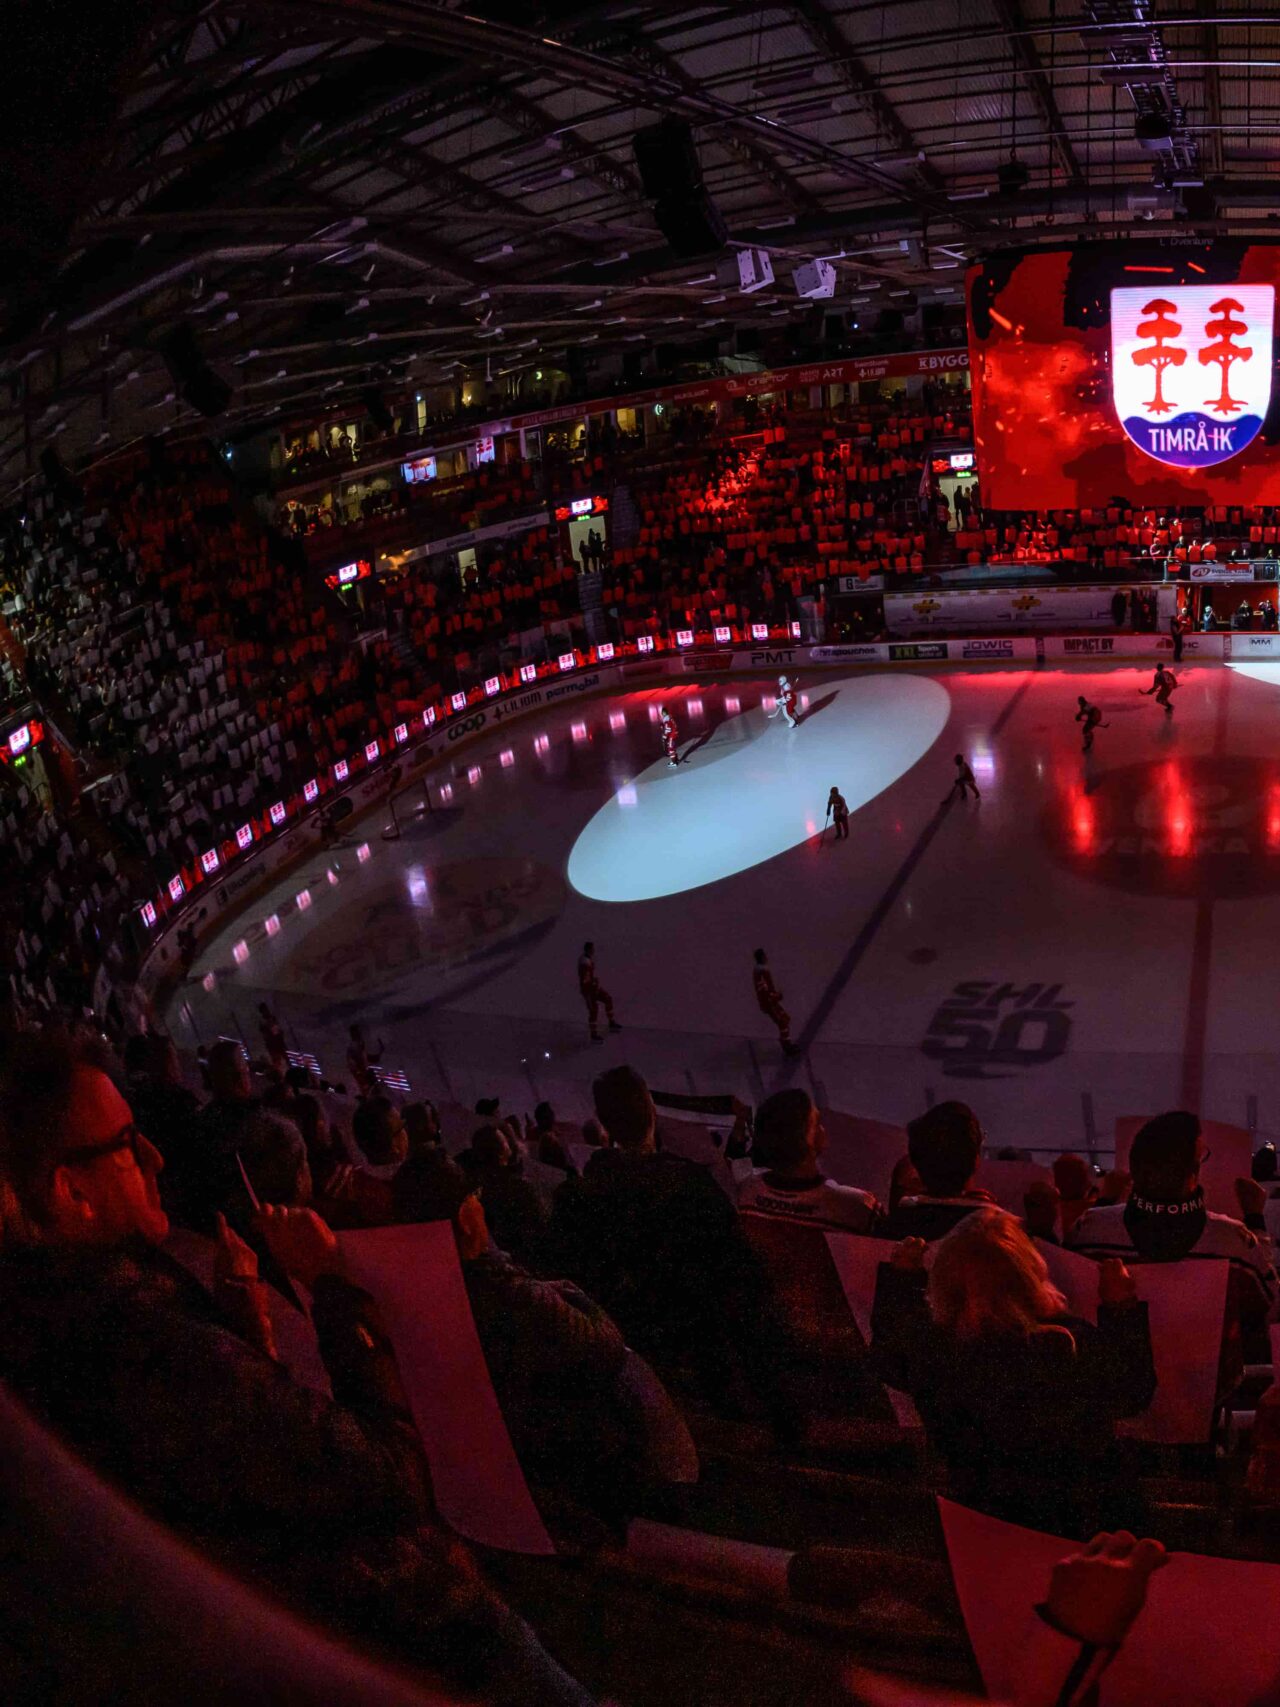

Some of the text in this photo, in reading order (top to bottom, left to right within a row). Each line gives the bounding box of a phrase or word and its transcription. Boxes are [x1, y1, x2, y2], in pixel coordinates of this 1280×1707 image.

[1148, 421, 1234, 452] TIMRÅ IK
[963, 639, 1013, 650] JOWIC
[1063, 638, 1100, 650] IMPACT
[751, 651, 795, 664] PMT
[545, 675, 600, 699] permobil
[448, 713, 486, 740] coop
[952, 980, 1075, 1009] SHL
[920, 1009, 1073, 1065] 50
